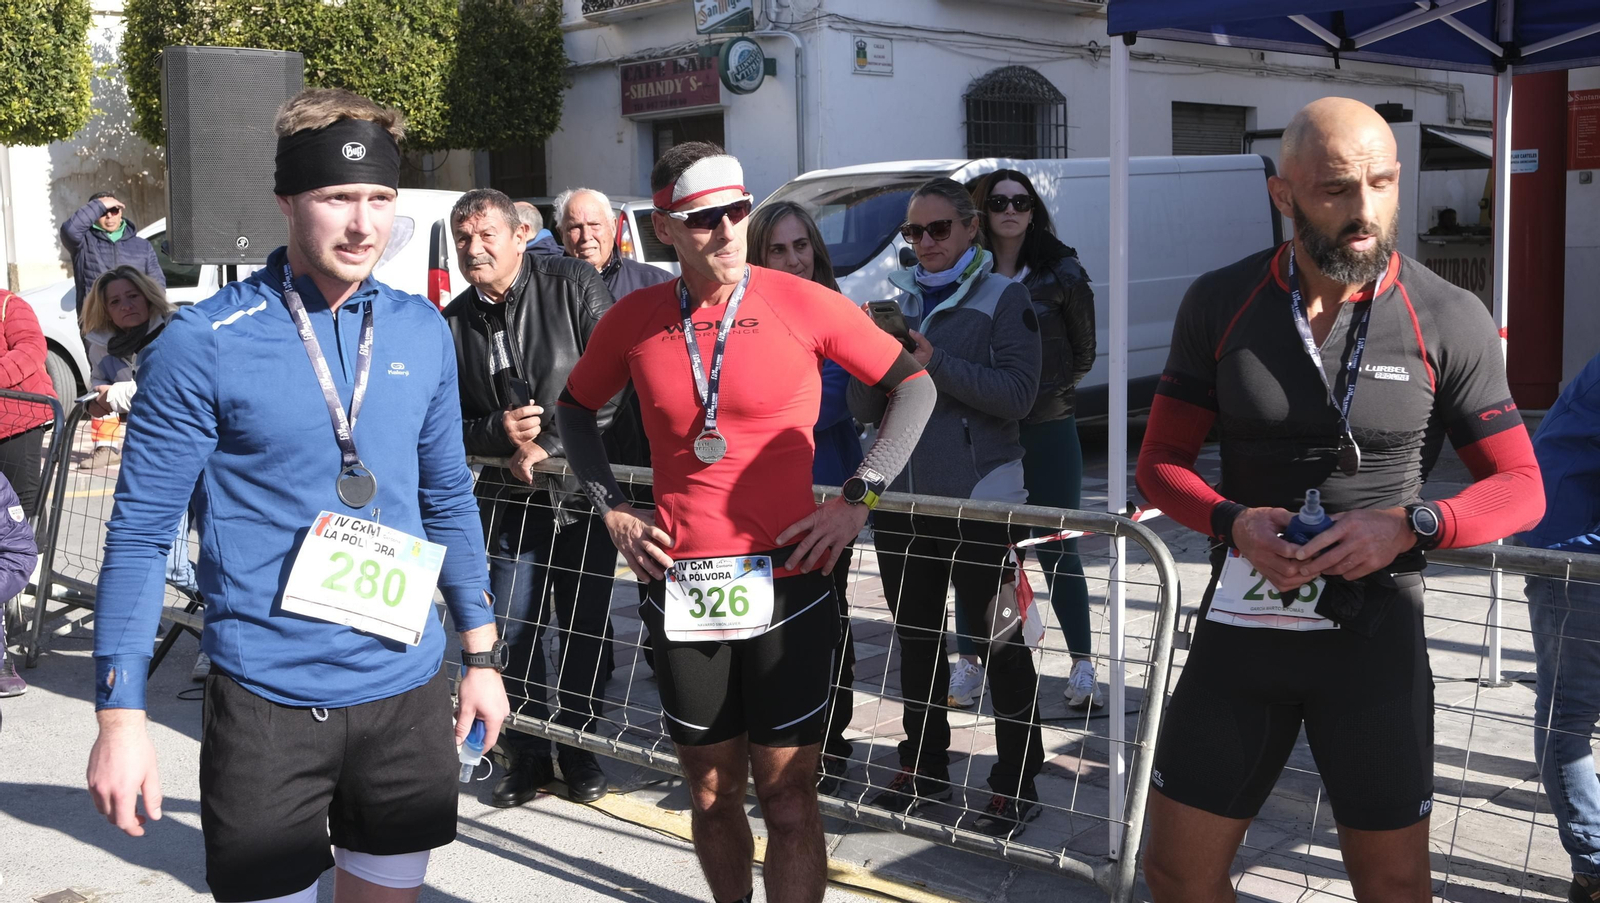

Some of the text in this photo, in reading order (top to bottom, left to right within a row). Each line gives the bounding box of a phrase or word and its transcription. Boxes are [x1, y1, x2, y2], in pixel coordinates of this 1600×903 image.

[1574, 92, 1600, 102] Santan
[1365, 364, 1409, 374] LURBEL
[334, 516, 381, 537] IV CxM
[323, 528, 337, 540] LA
[690, 560, 713, 570] CxM
[321, 551, 406, 607] 280
[676, 571, 732, 582] LA PÓLVORA
[688, 585, 750, 619] 326
